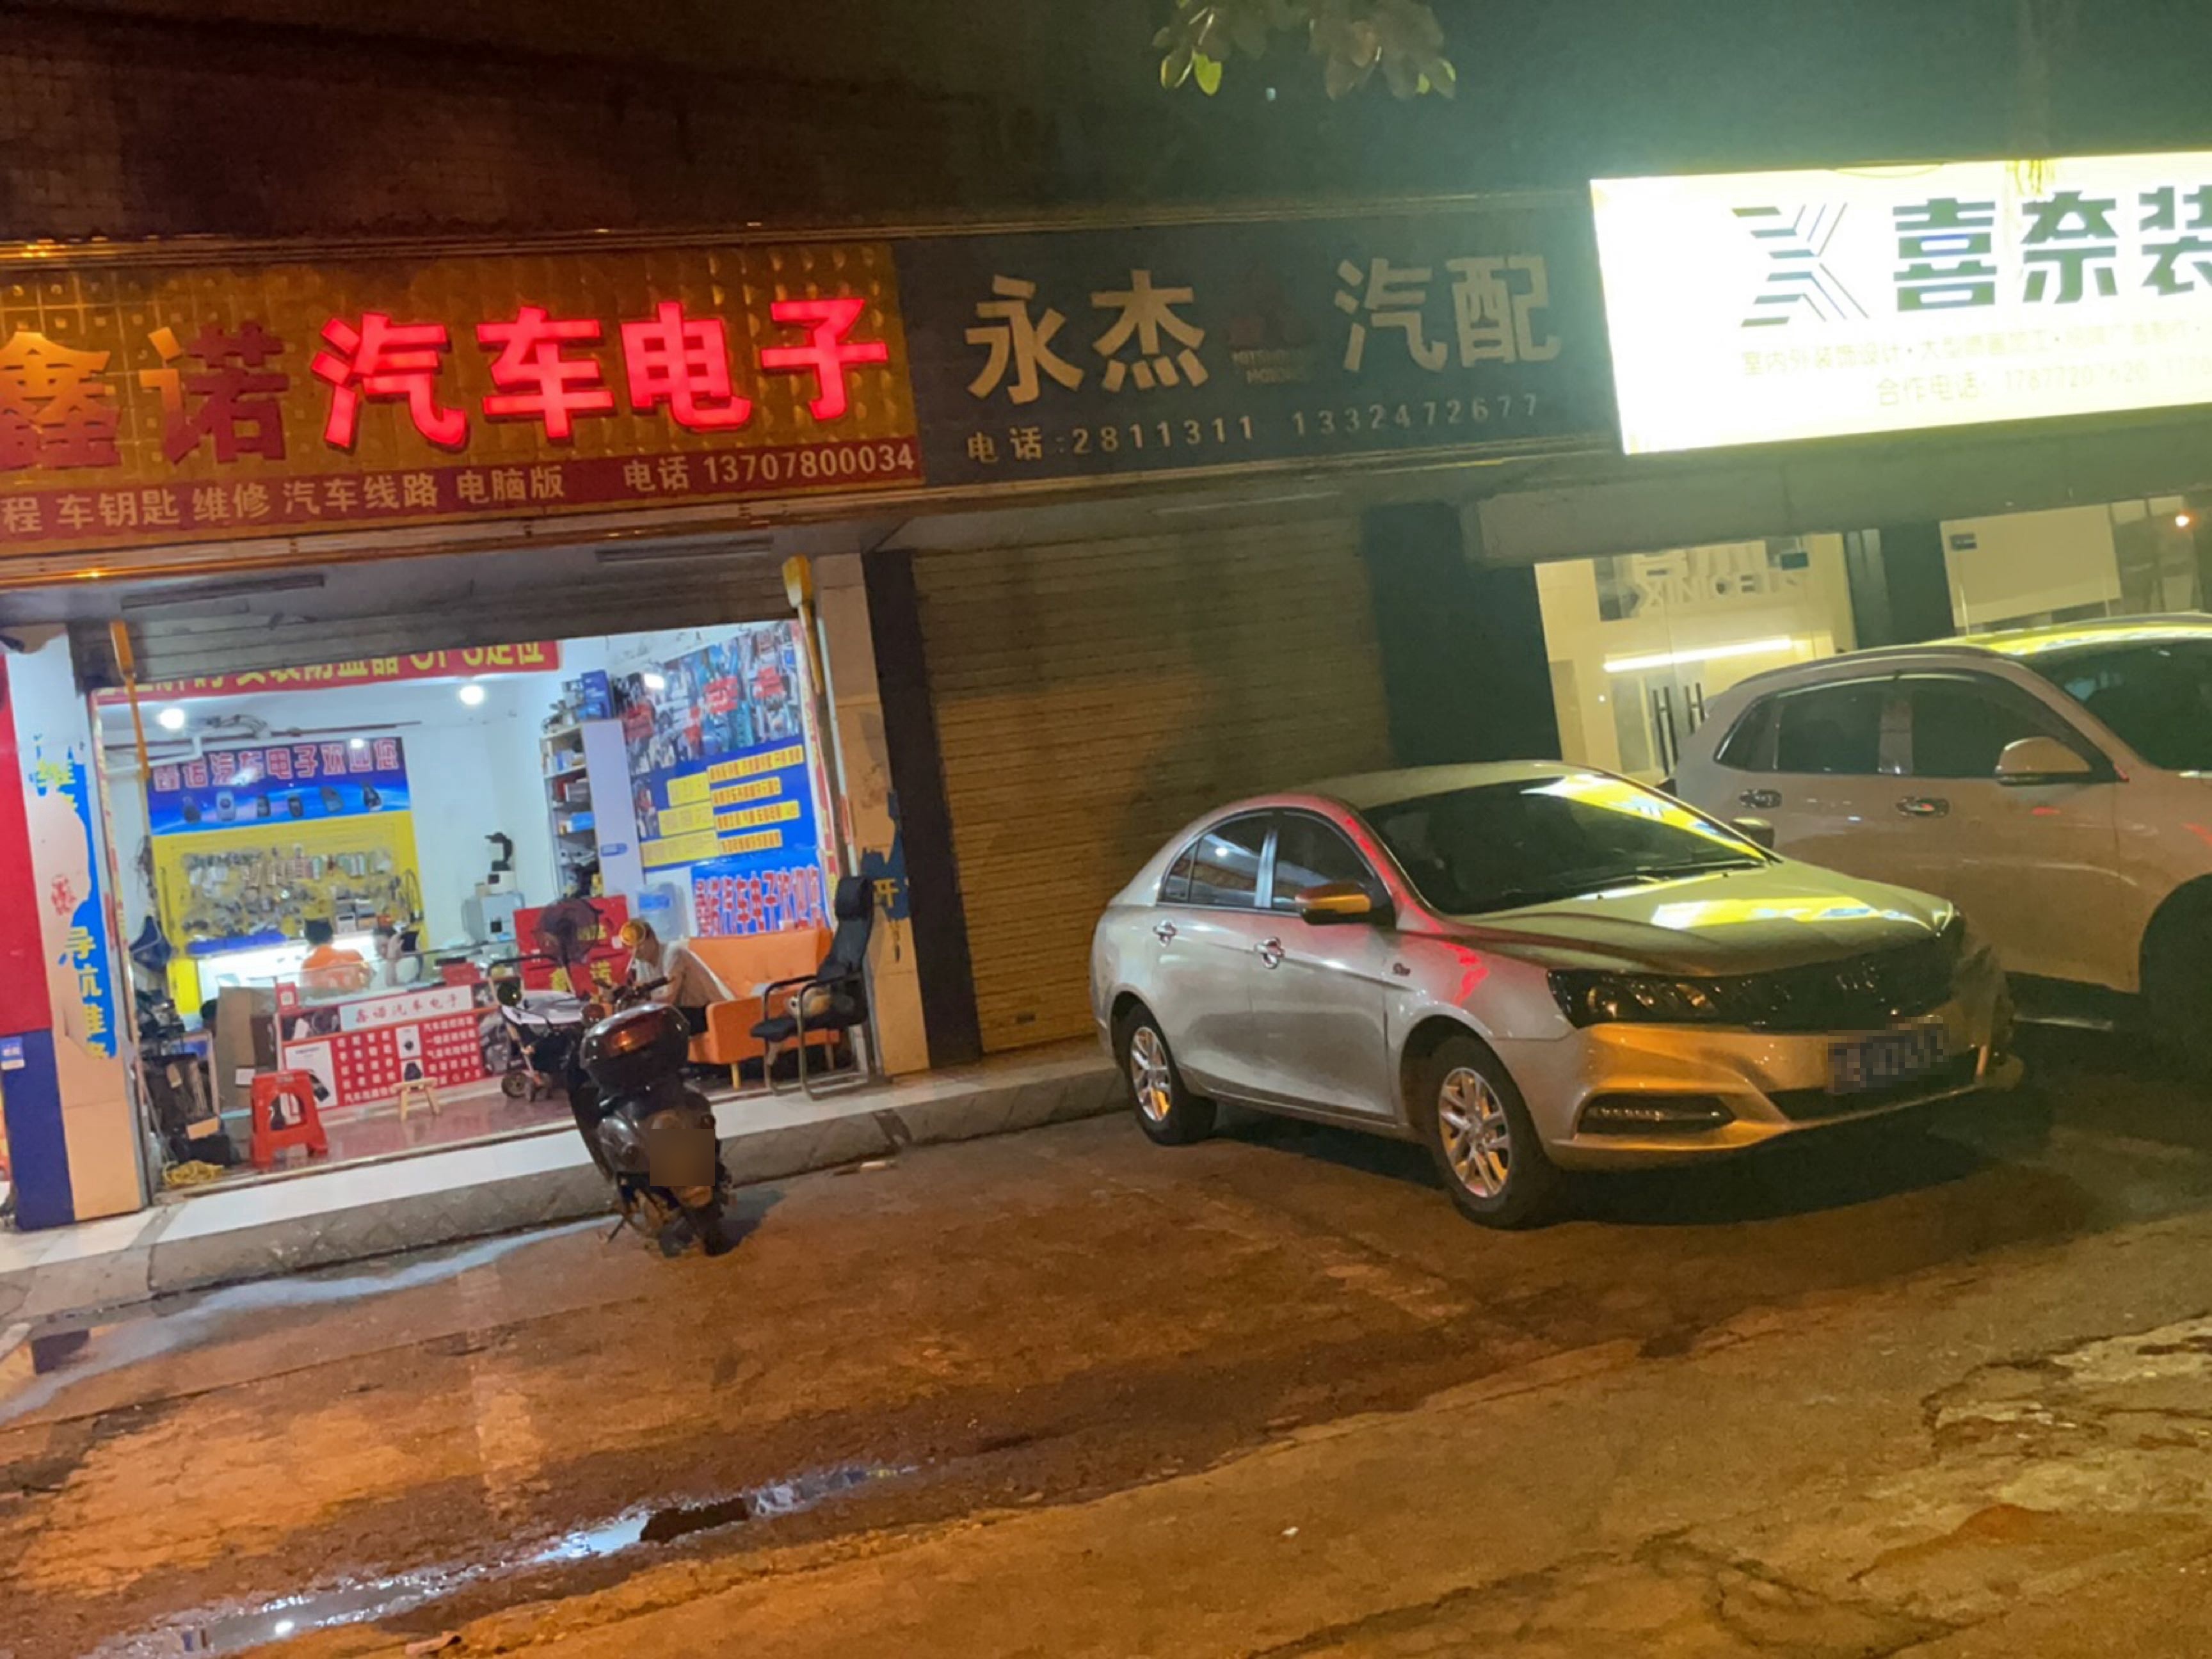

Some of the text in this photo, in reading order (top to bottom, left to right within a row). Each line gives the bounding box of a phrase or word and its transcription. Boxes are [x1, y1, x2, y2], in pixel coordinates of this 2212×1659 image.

[965, 254, 1562, 405] 永杰 汽配
[1292, 392, 1536, 437] 1332472677
[58, 488, 180, 531] 车钥匙
[193, 482, 271, 522] 维修
[282, 474, 438, 515] 汽车线路
[456, 465, 565, 504] 电脑版
[623, 456, 689, 492] 电话
[703, 443, 915, 484] 13707800034
